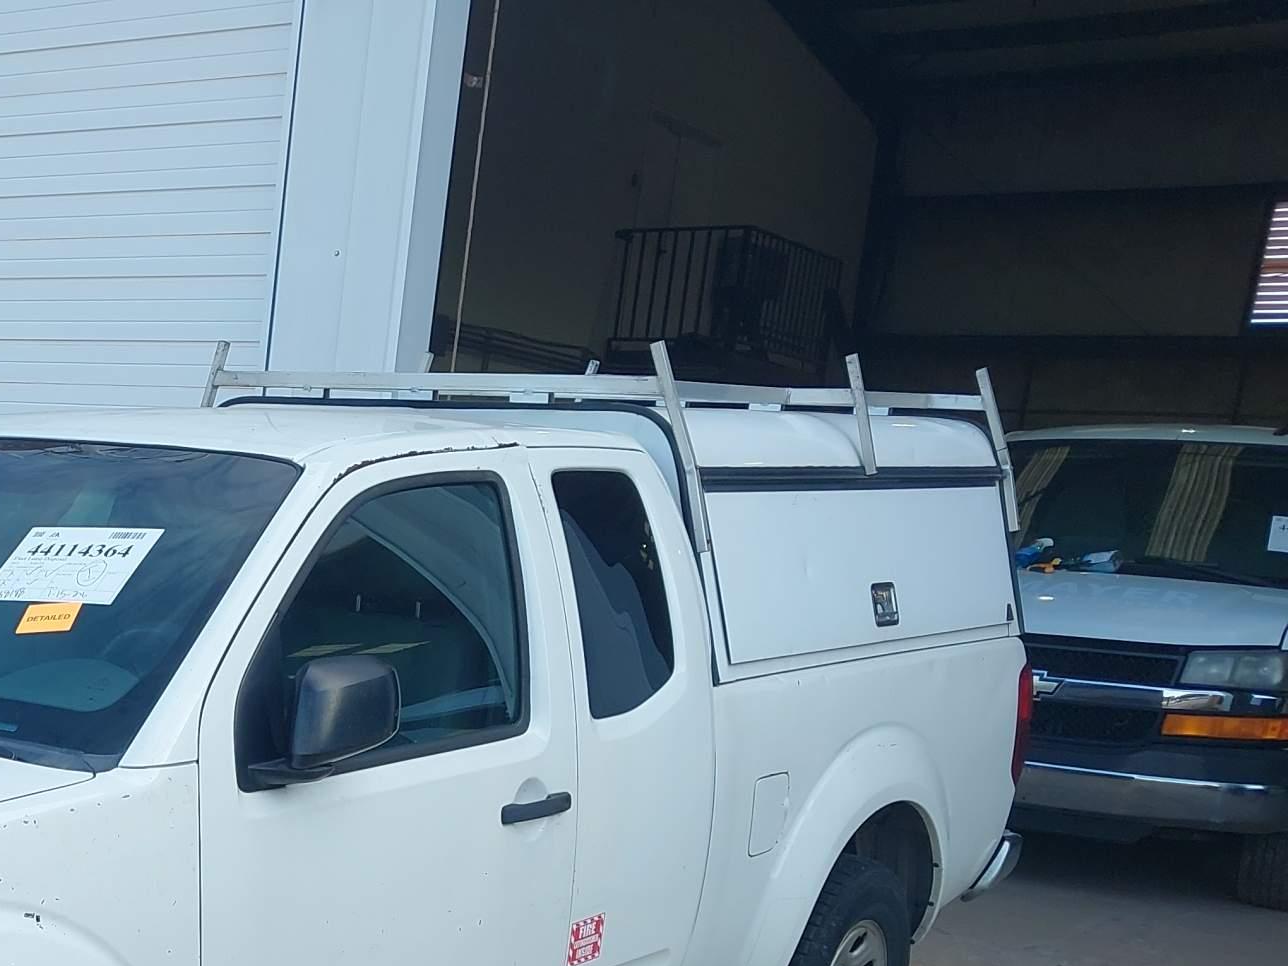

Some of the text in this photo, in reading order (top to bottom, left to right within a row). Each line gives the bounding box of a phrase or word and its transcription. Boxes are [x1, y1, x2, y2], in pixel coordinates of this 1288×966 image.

[27, 543, 134, 559] 44114364
[26, 613, 71, 623] DETAILED
[578, 921, 597, 939] FIRE
